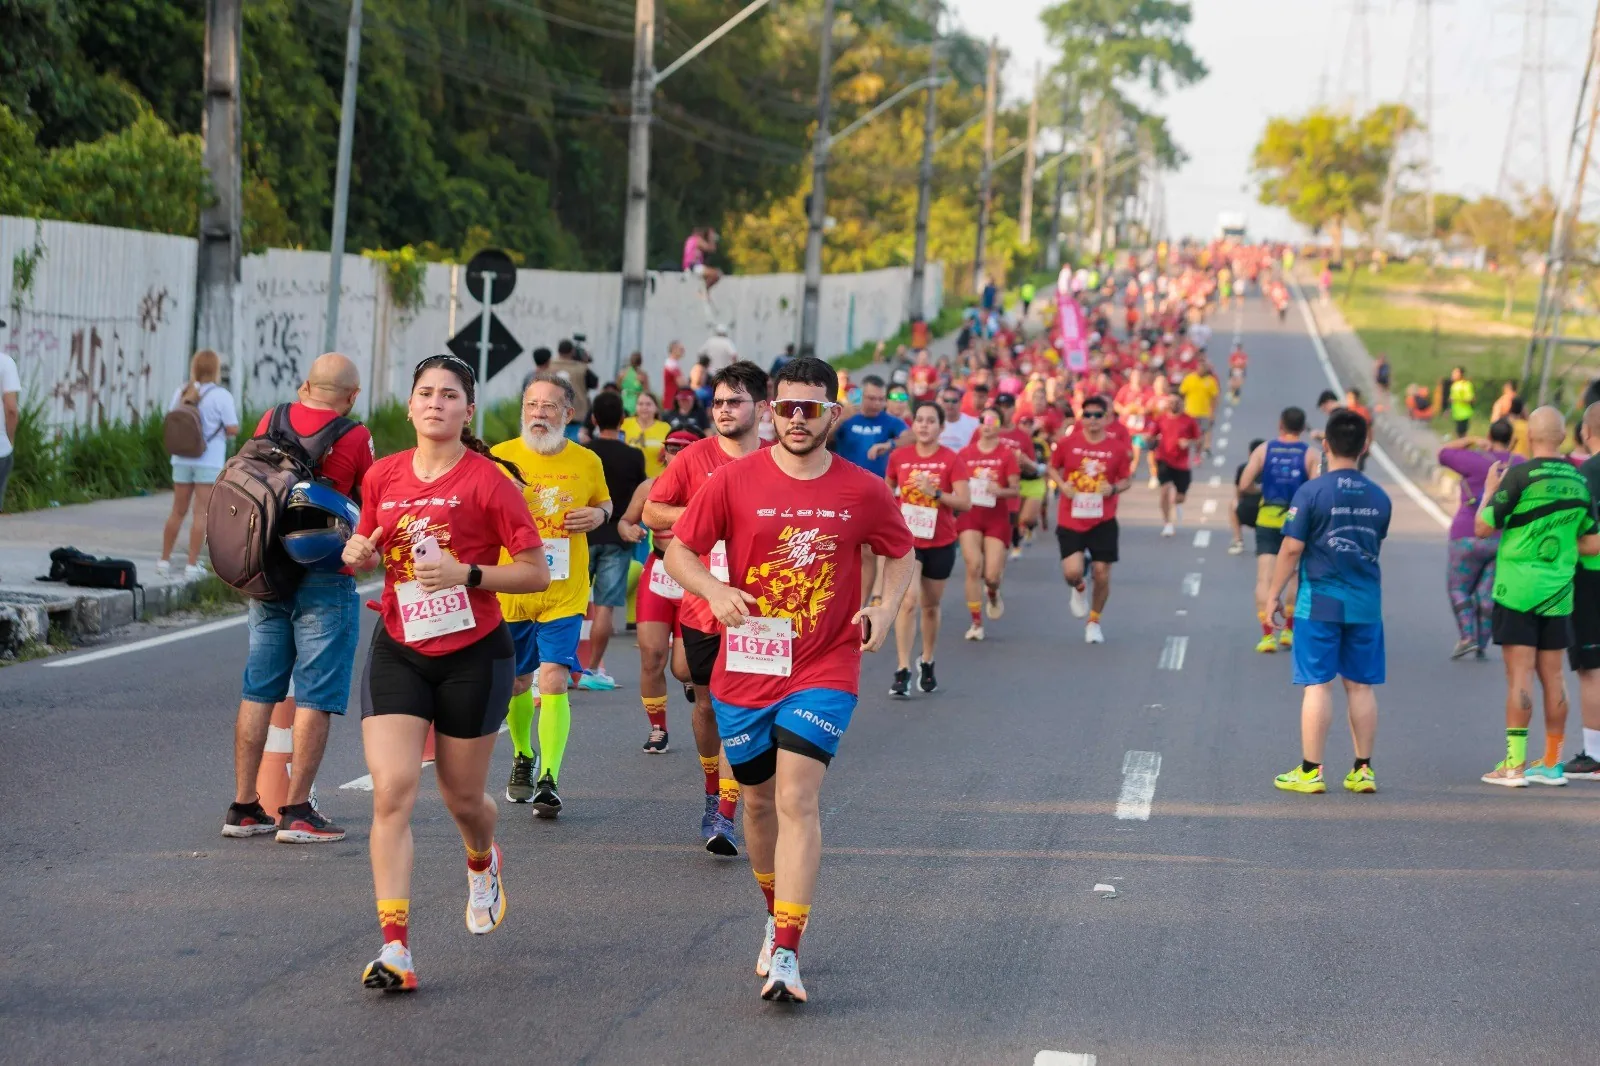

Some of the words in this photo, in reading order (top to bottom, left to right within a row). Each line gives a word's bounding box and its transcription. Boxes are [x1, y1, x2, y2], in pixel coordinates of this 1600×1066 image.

[406, 515, 431, 534] COR
[787, 527, 820, 547] COR
[792, 552, 817, 569] DA
[406, 594, 461, 621] 2489
[733, 635, 785, 656] 1673
